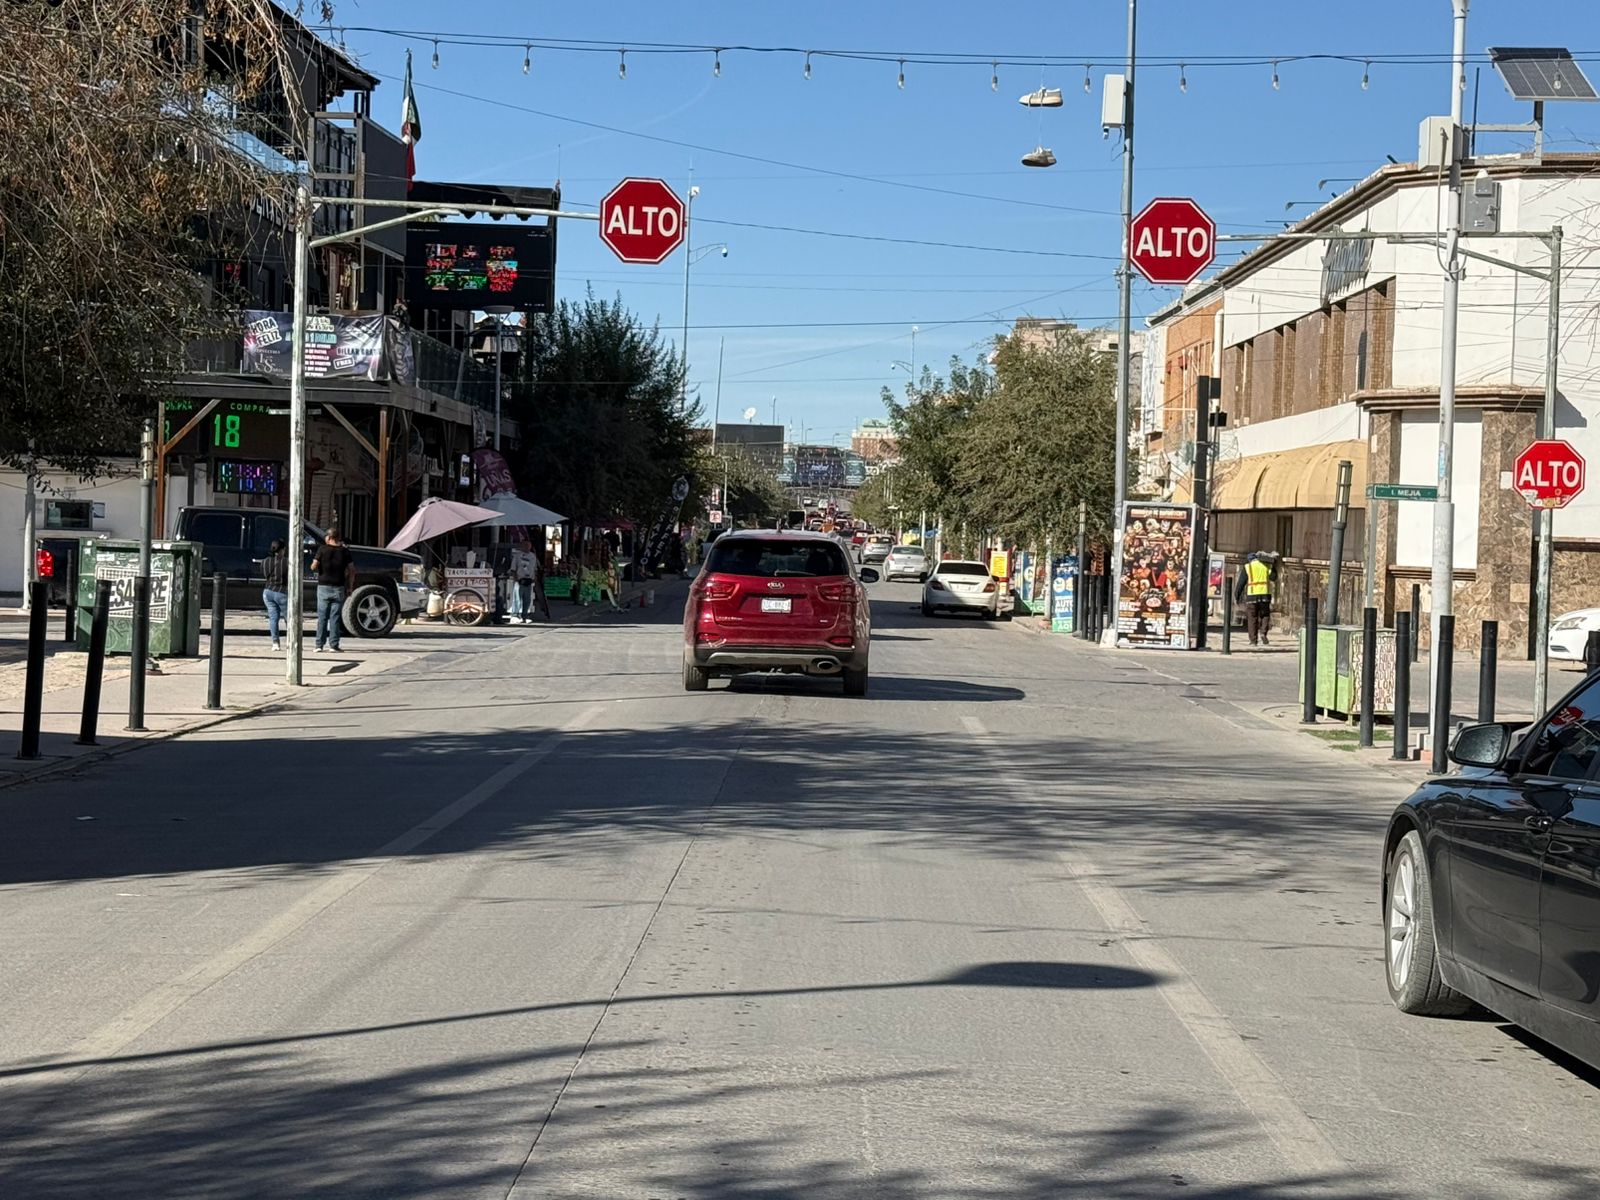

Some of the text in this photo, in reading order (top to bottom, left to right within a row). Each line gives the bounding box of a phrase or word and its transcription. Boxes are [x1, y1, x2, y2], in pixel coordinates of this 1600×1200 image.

[606, 204, 679, 237] ALTO
[1135, 227, 1208, 258] ALTO
[250, 318, 276, 334] HORA
[257, 331, 280, 346] FELIZ
[214, 414, 240, 448] 18
[1518, 460, 1580, 488] ALTO
